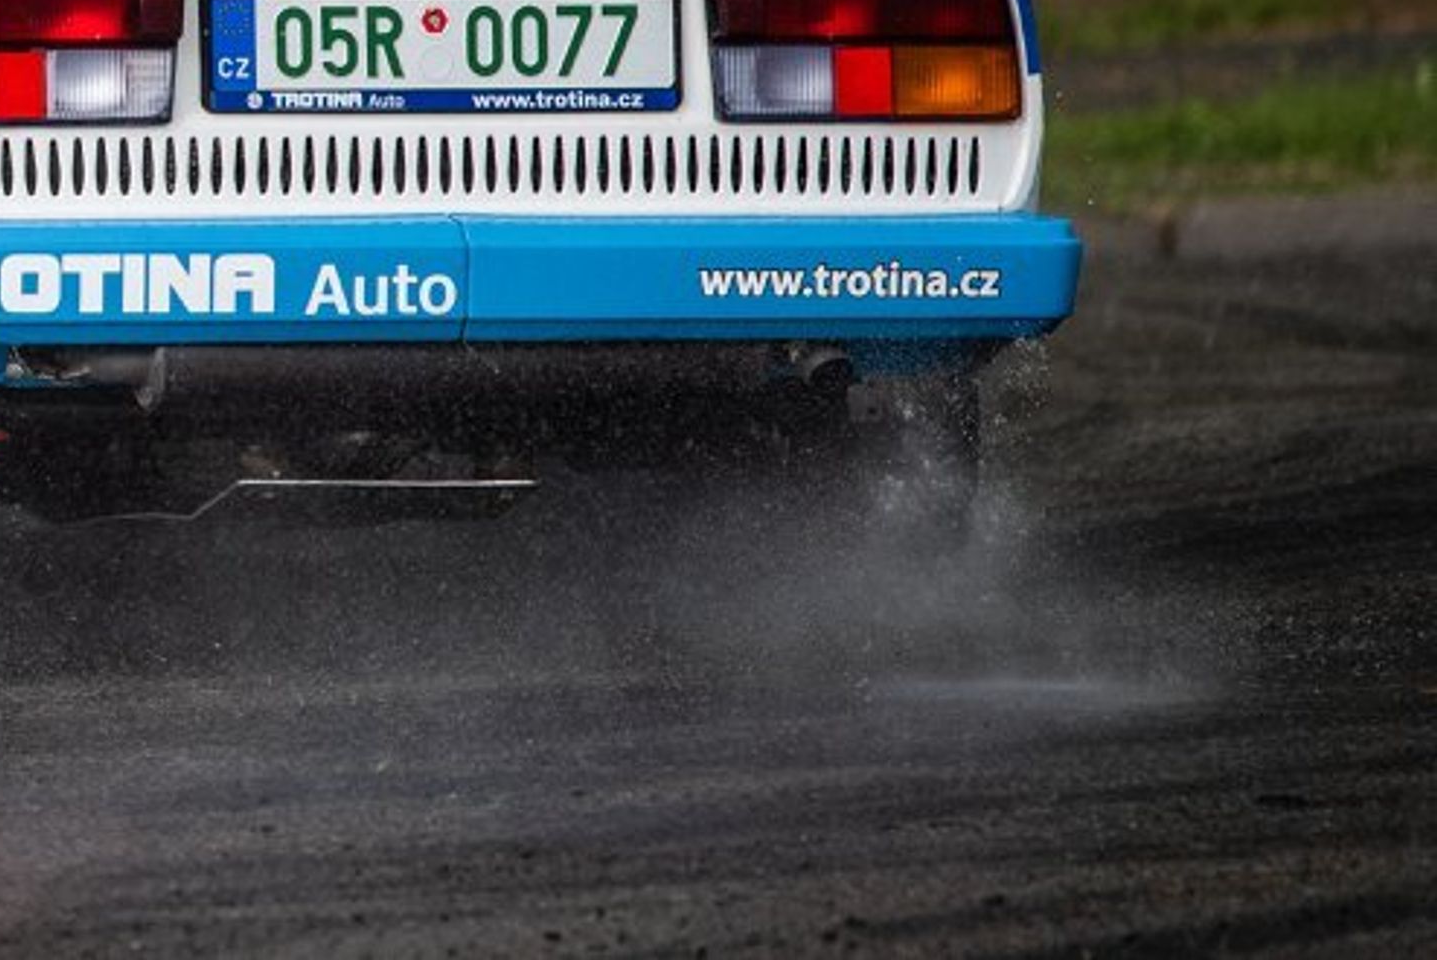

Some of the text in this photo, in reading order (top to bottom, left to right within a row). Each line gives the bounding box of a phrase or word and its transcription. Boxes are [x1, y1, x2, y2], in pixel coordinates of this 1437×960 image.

[275, 5, 640, 79] 05R 0077
[217, 57, 250, 79] CZ
[270, 89, 645, 110] TROTINA Auto www.trotina.cz
[304, 264, 459, 316] Auto
[699, 262, 1002, 300] www.trotina.cz
